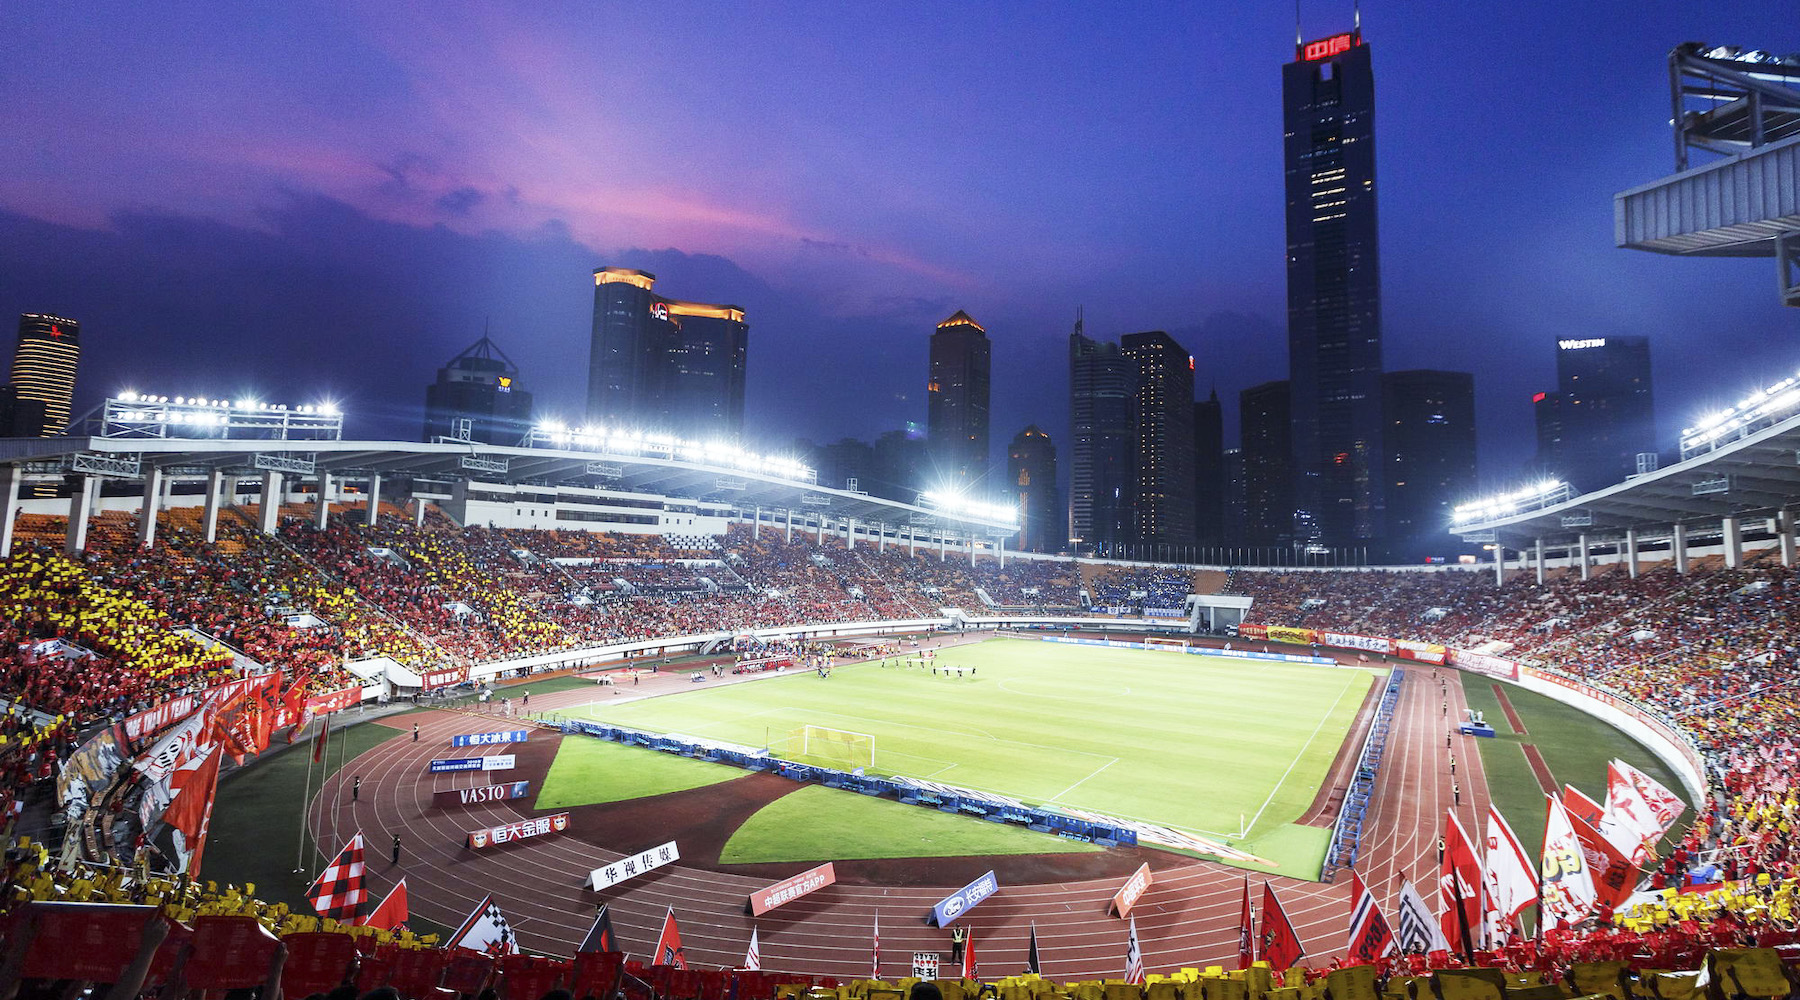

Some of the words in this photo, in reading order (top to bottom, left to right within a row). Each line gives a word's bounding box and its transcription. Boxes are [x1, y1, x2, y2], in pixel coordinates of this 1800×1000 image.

[1305, 34, 1350, 61] 中信
[171, 695, 193, 719] TEAM
[469, 732, 512, 745] 恒大冰泉
[460, 786, 505, 804] VASTO
[491, 818, 551, 844] 恒大金服
[605, 847, 672, 883] 华视传媒
[764, 874, 825, 908] 中超联赛官方APP
[965, 877, 993, 904] 长安福特
